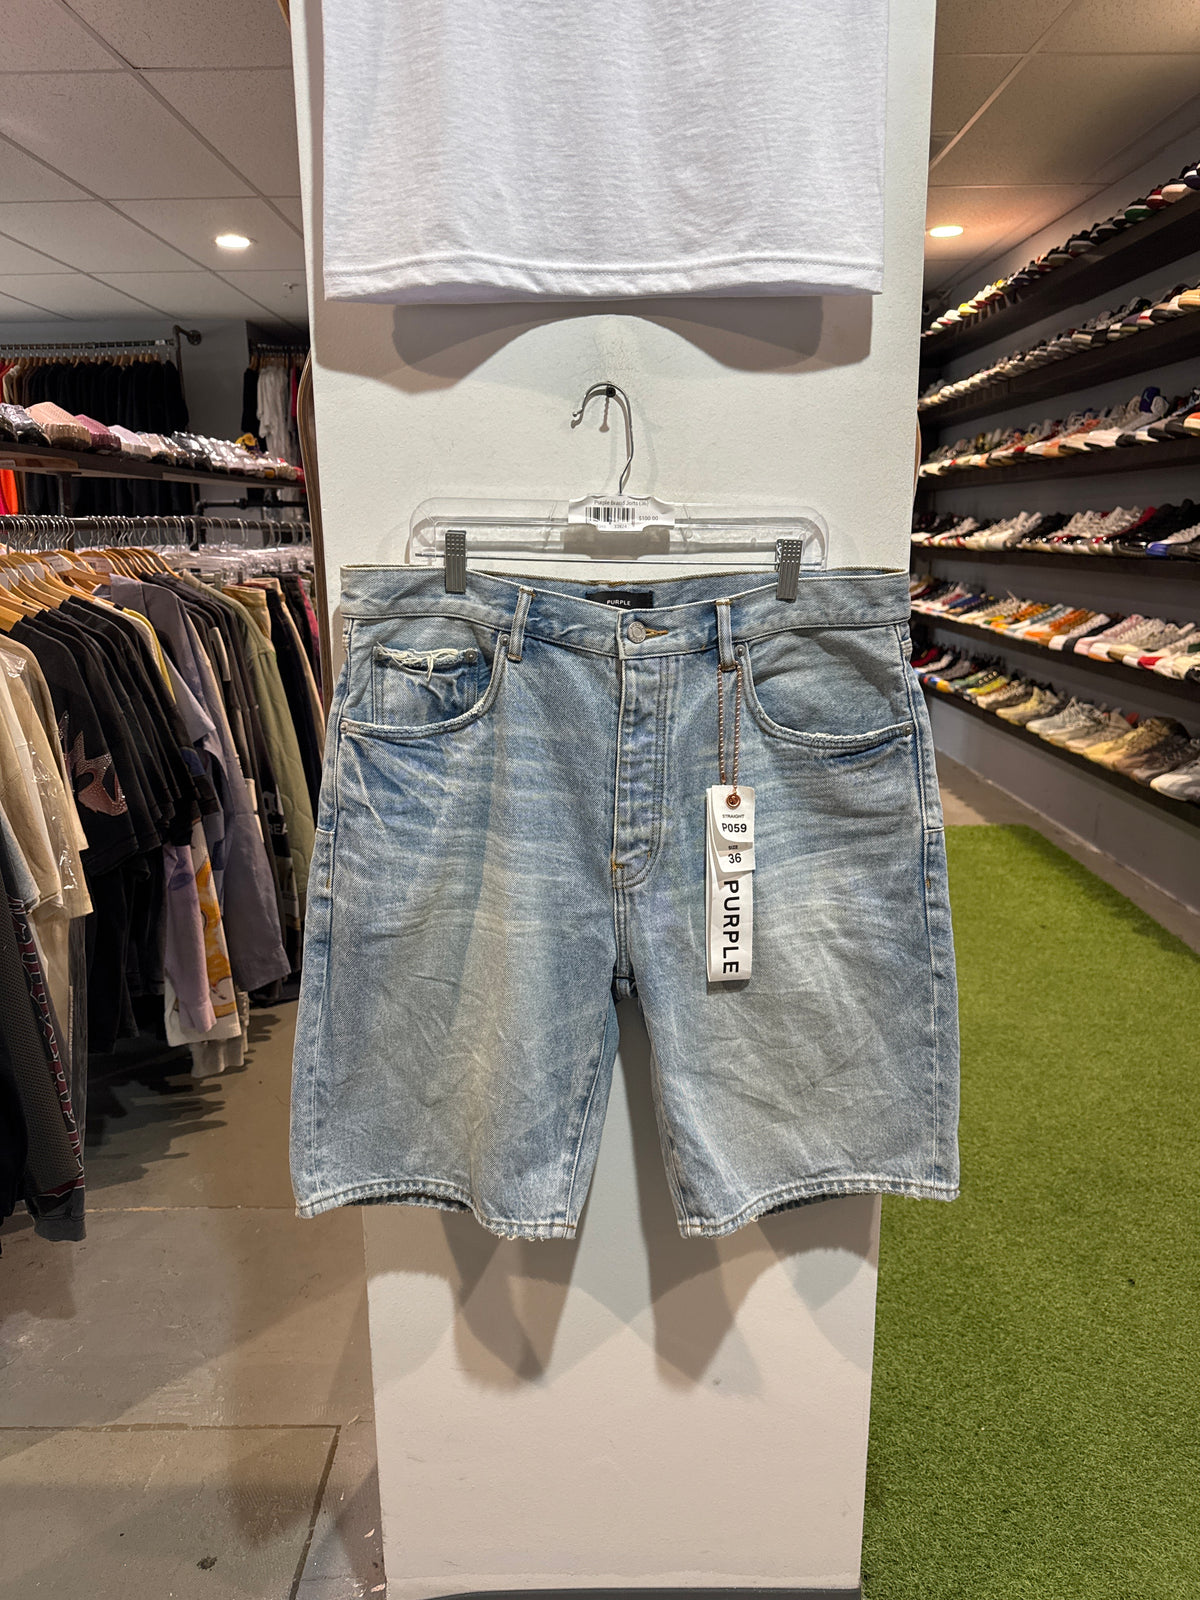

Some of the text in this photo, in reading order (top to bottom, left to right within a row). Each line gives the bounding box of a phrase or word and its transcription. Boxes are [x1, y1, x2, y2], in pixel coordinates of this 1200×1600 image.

[721, 822, 747, 833] P059
[728, 852, 742, 864] 36
[722, 880, 740, 974] PURPLE
